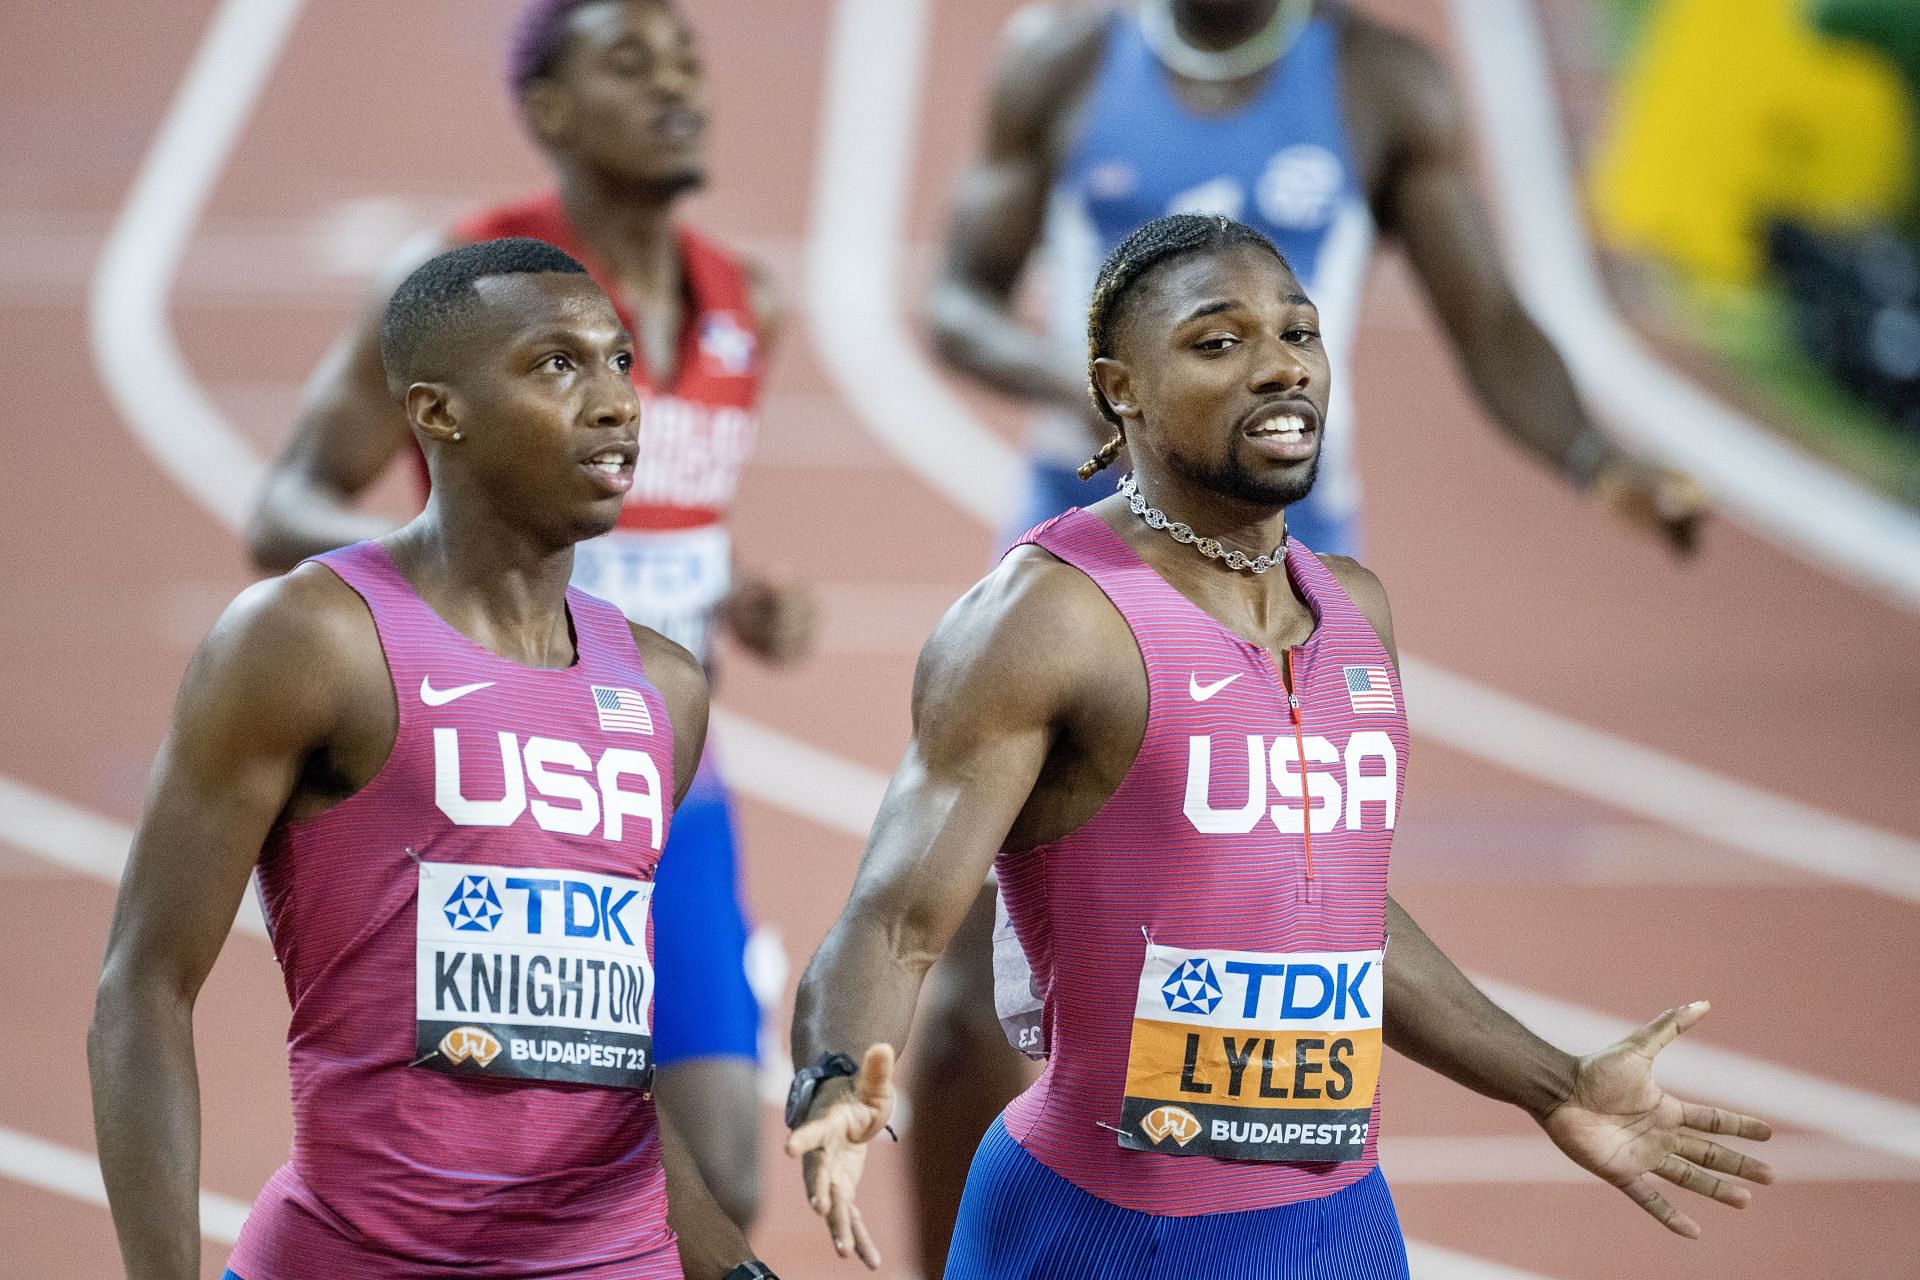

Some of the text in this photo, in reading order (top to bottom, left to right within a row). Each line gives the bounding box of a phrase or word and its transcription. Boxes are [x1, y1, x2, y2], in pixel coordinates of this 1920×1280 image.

[433, 727, 663, 851] USA
[1183, 731, 1397, 834] USA
[505, 877, 640, 946] TDK
[435, 951, 645, 1025] KNIGHTON
[1225, 961, 1372, 1020] TDK
[1179, 1033, 1354, 1100] LYLES
